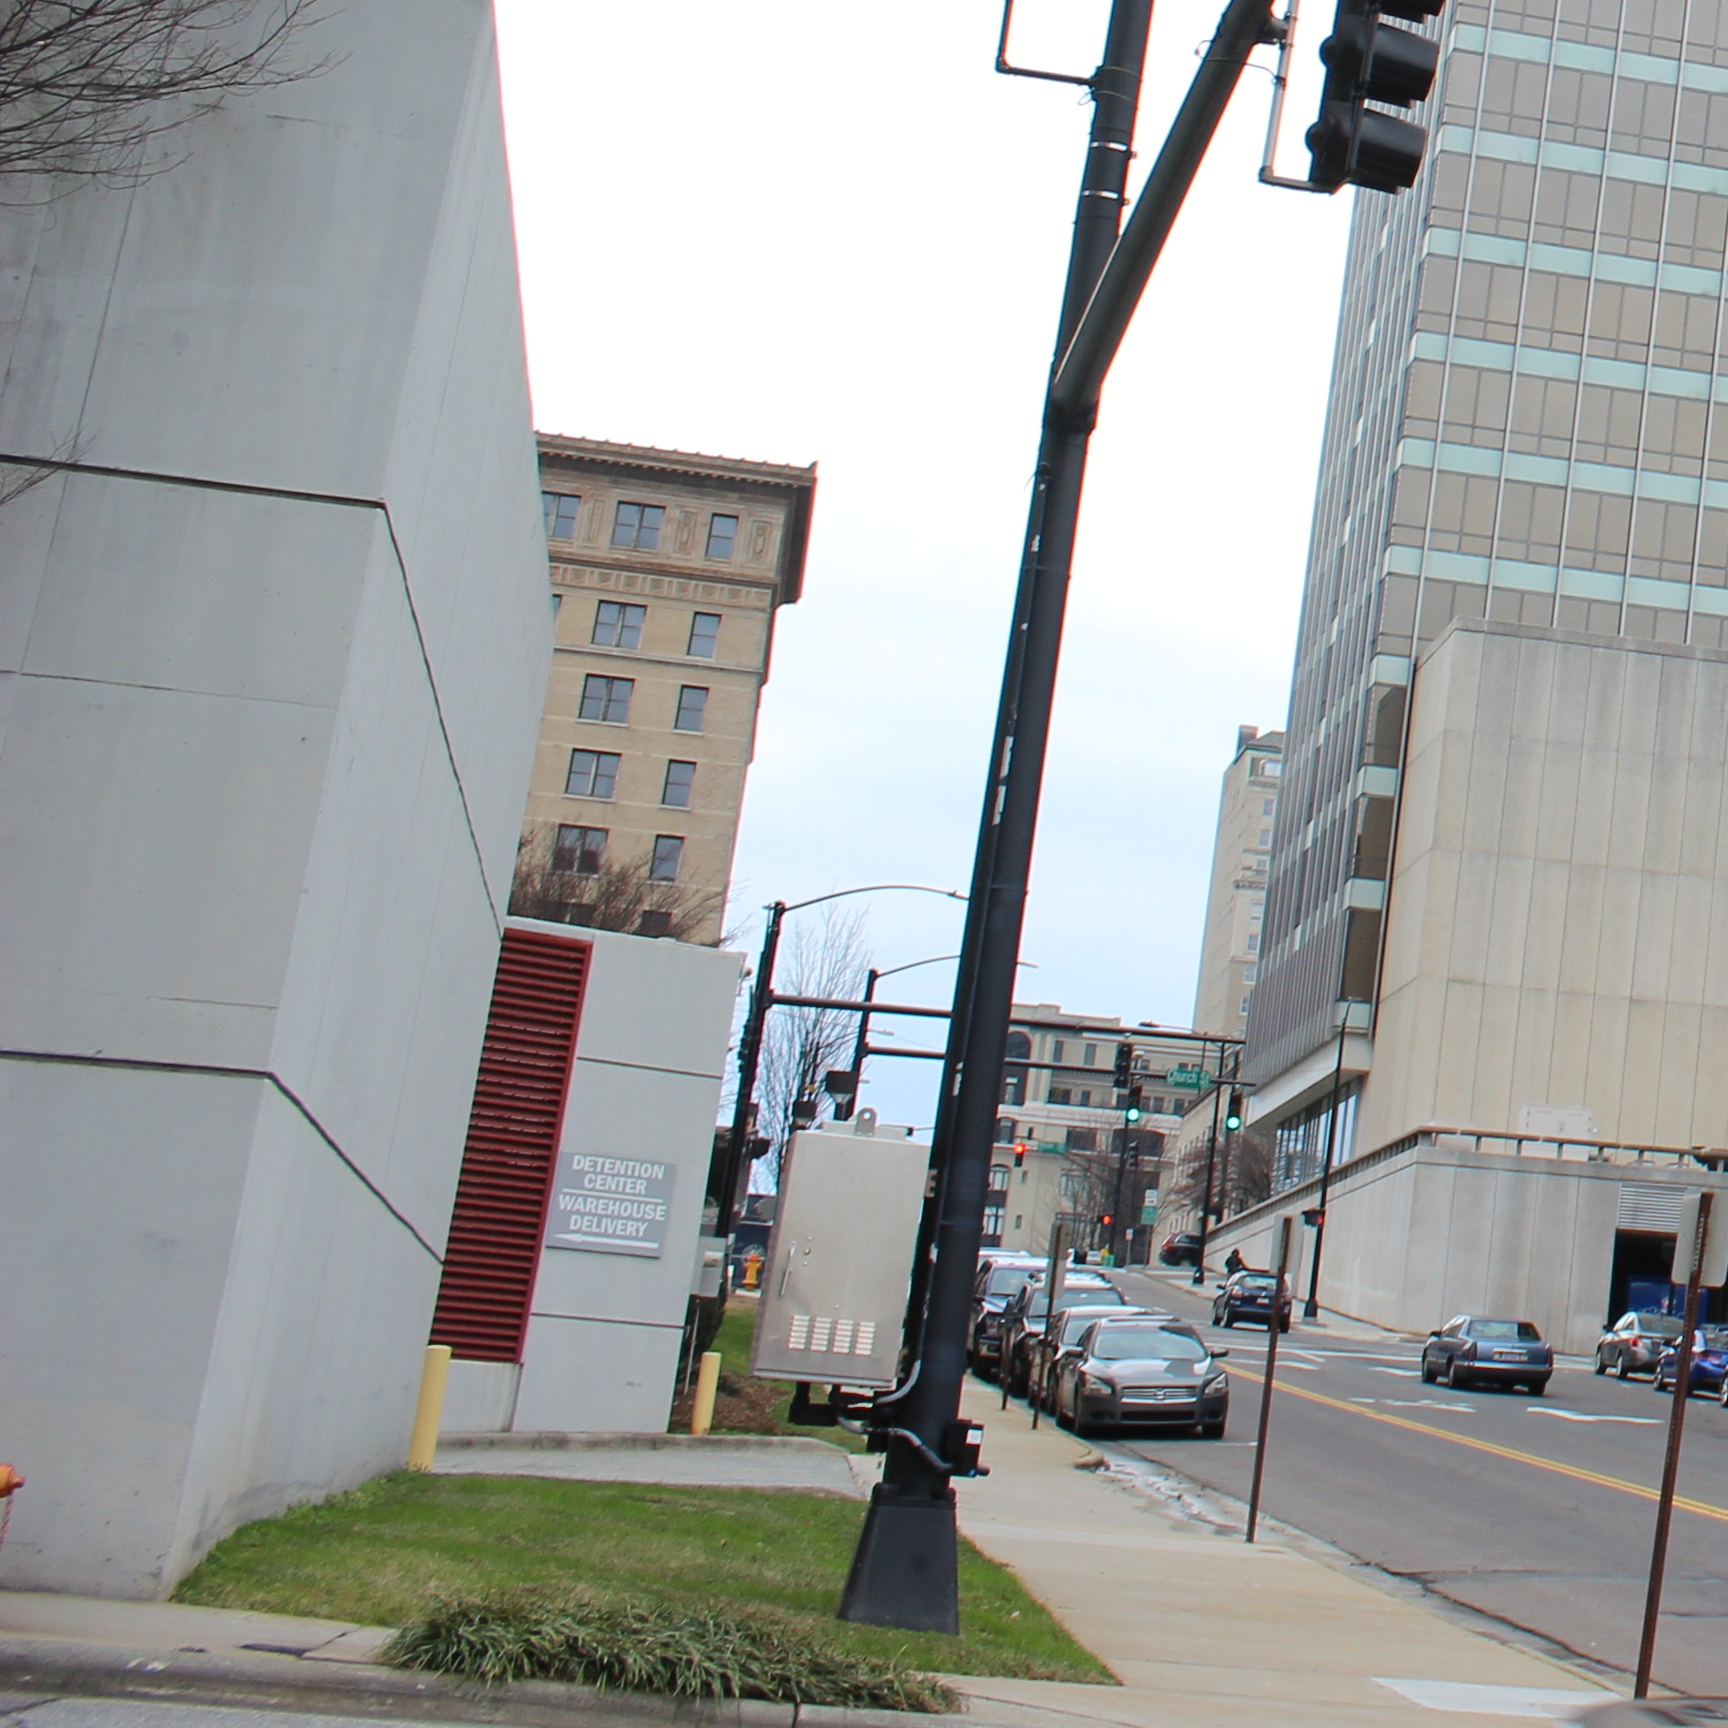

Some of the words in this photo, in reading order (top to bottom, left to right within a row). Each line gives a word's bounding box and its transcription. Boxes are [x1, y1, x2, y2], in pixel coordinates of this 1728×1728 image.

[1167, 1069, 1198, 1085] Church
[572, 1155, 665, 1180] DETENTION
[583, 1173, 647, 1195] CENTER
[559, 1194, 667, 1221] WAREHOUSE
[569, 1214, 649, 1238] DELIVERY
